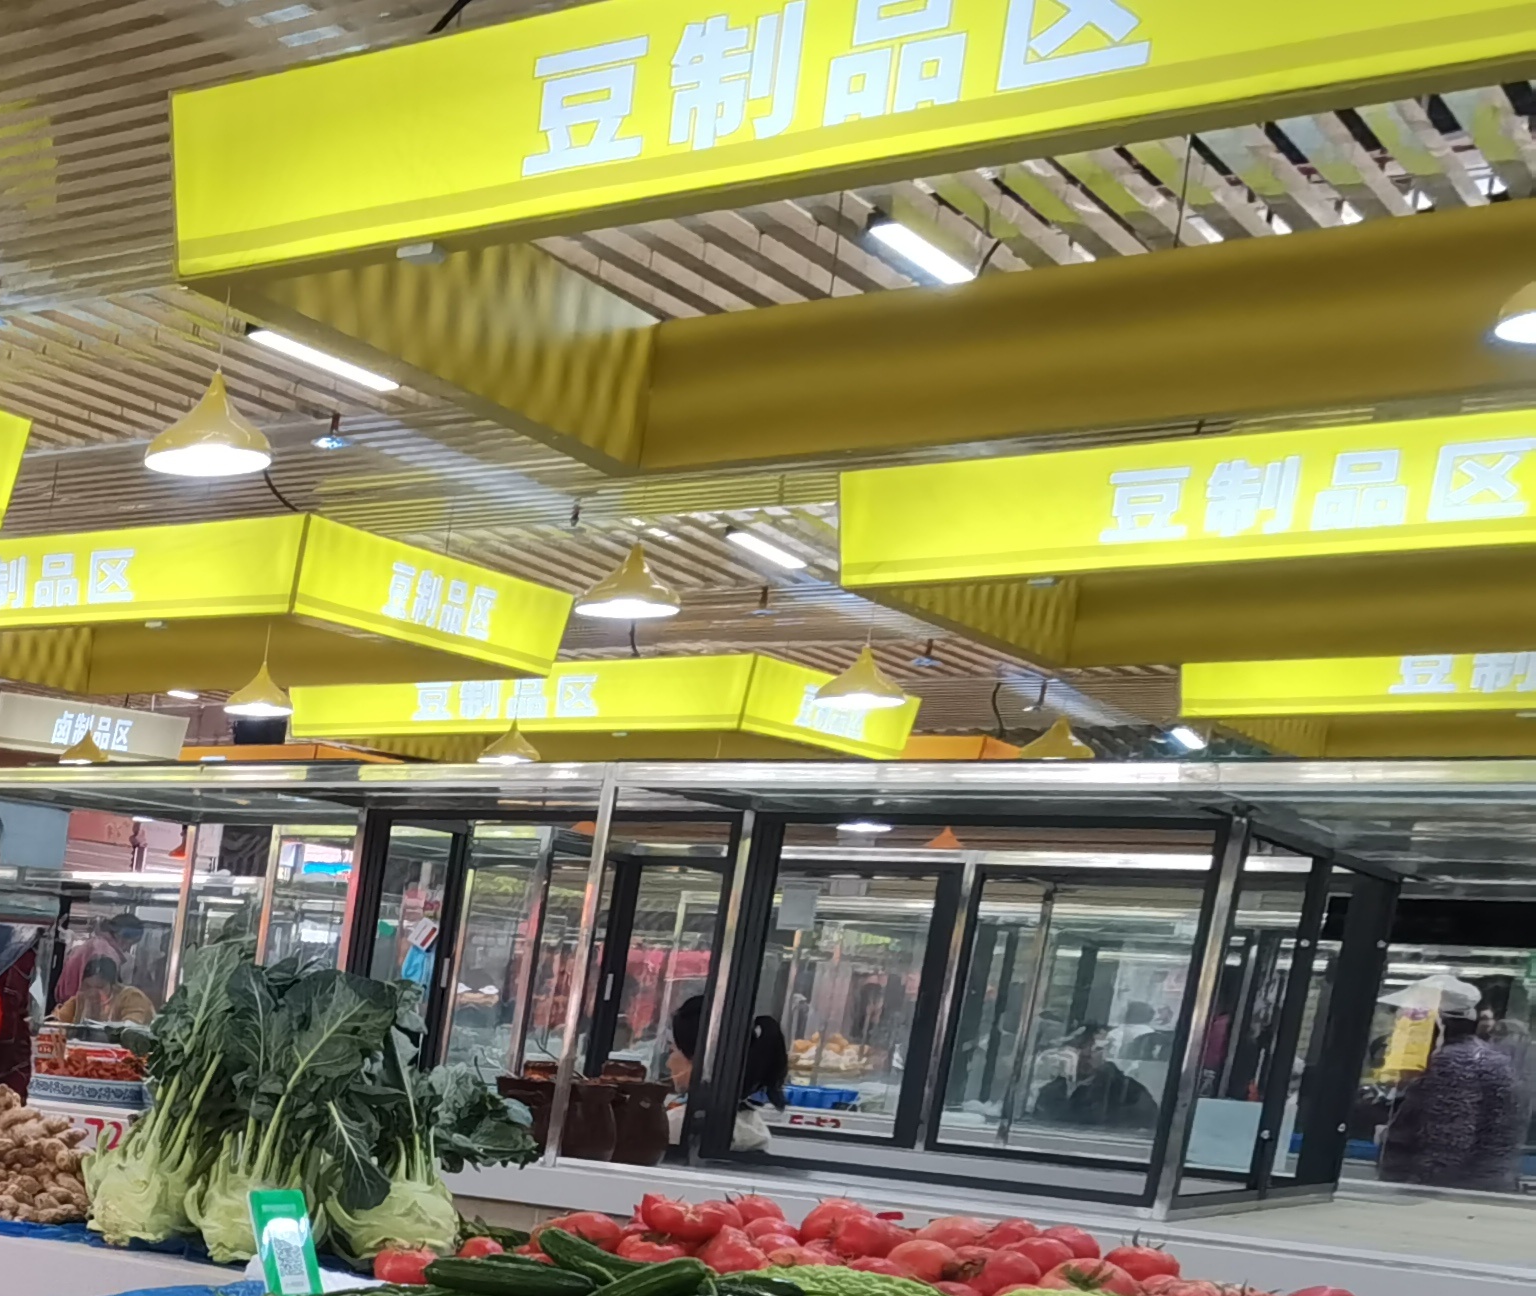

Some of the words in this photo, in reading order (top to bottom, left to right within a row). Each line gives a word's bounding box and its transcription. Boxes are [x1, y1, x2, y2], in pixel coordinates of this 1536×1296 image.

[521, 0, 1152, 178] 豆制品区
[1099, 437, 1536, 544] 豆制品区
[381, 561, 498, 641] 豆制品区
[51, 710, 134, 752] 卤制品区
[412, 674, 599, 722] 豆制品区
